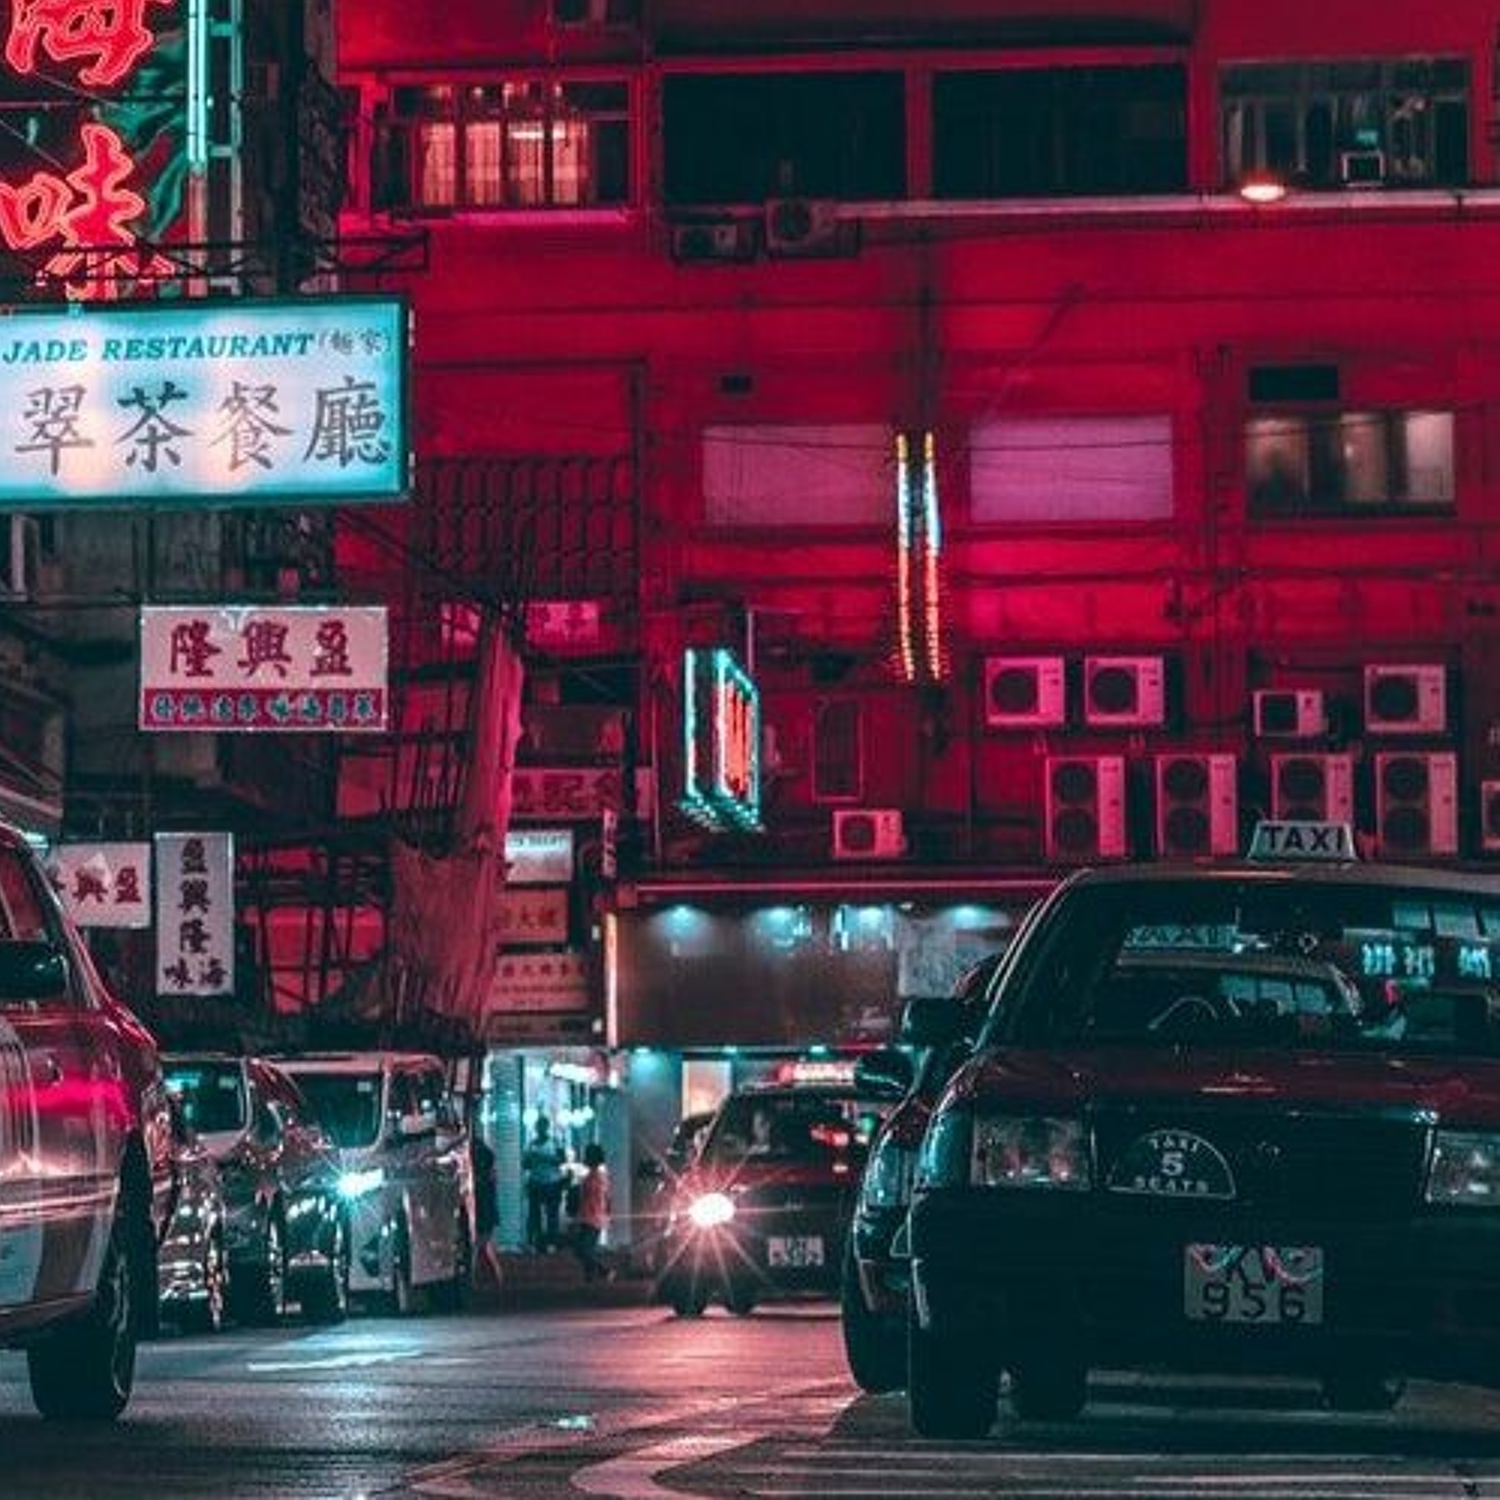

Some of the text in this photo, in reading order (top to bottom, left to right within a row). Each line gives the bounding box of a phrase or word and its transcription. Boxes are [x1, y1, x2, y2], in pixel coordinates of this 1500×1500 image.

[1, 338, 89, 365] JADE
[102, 333, 315, 360] RESTAURANT
[1261, 825, 1342, 851] TAXI
[1161, 1152, 1186, 1177] 5
